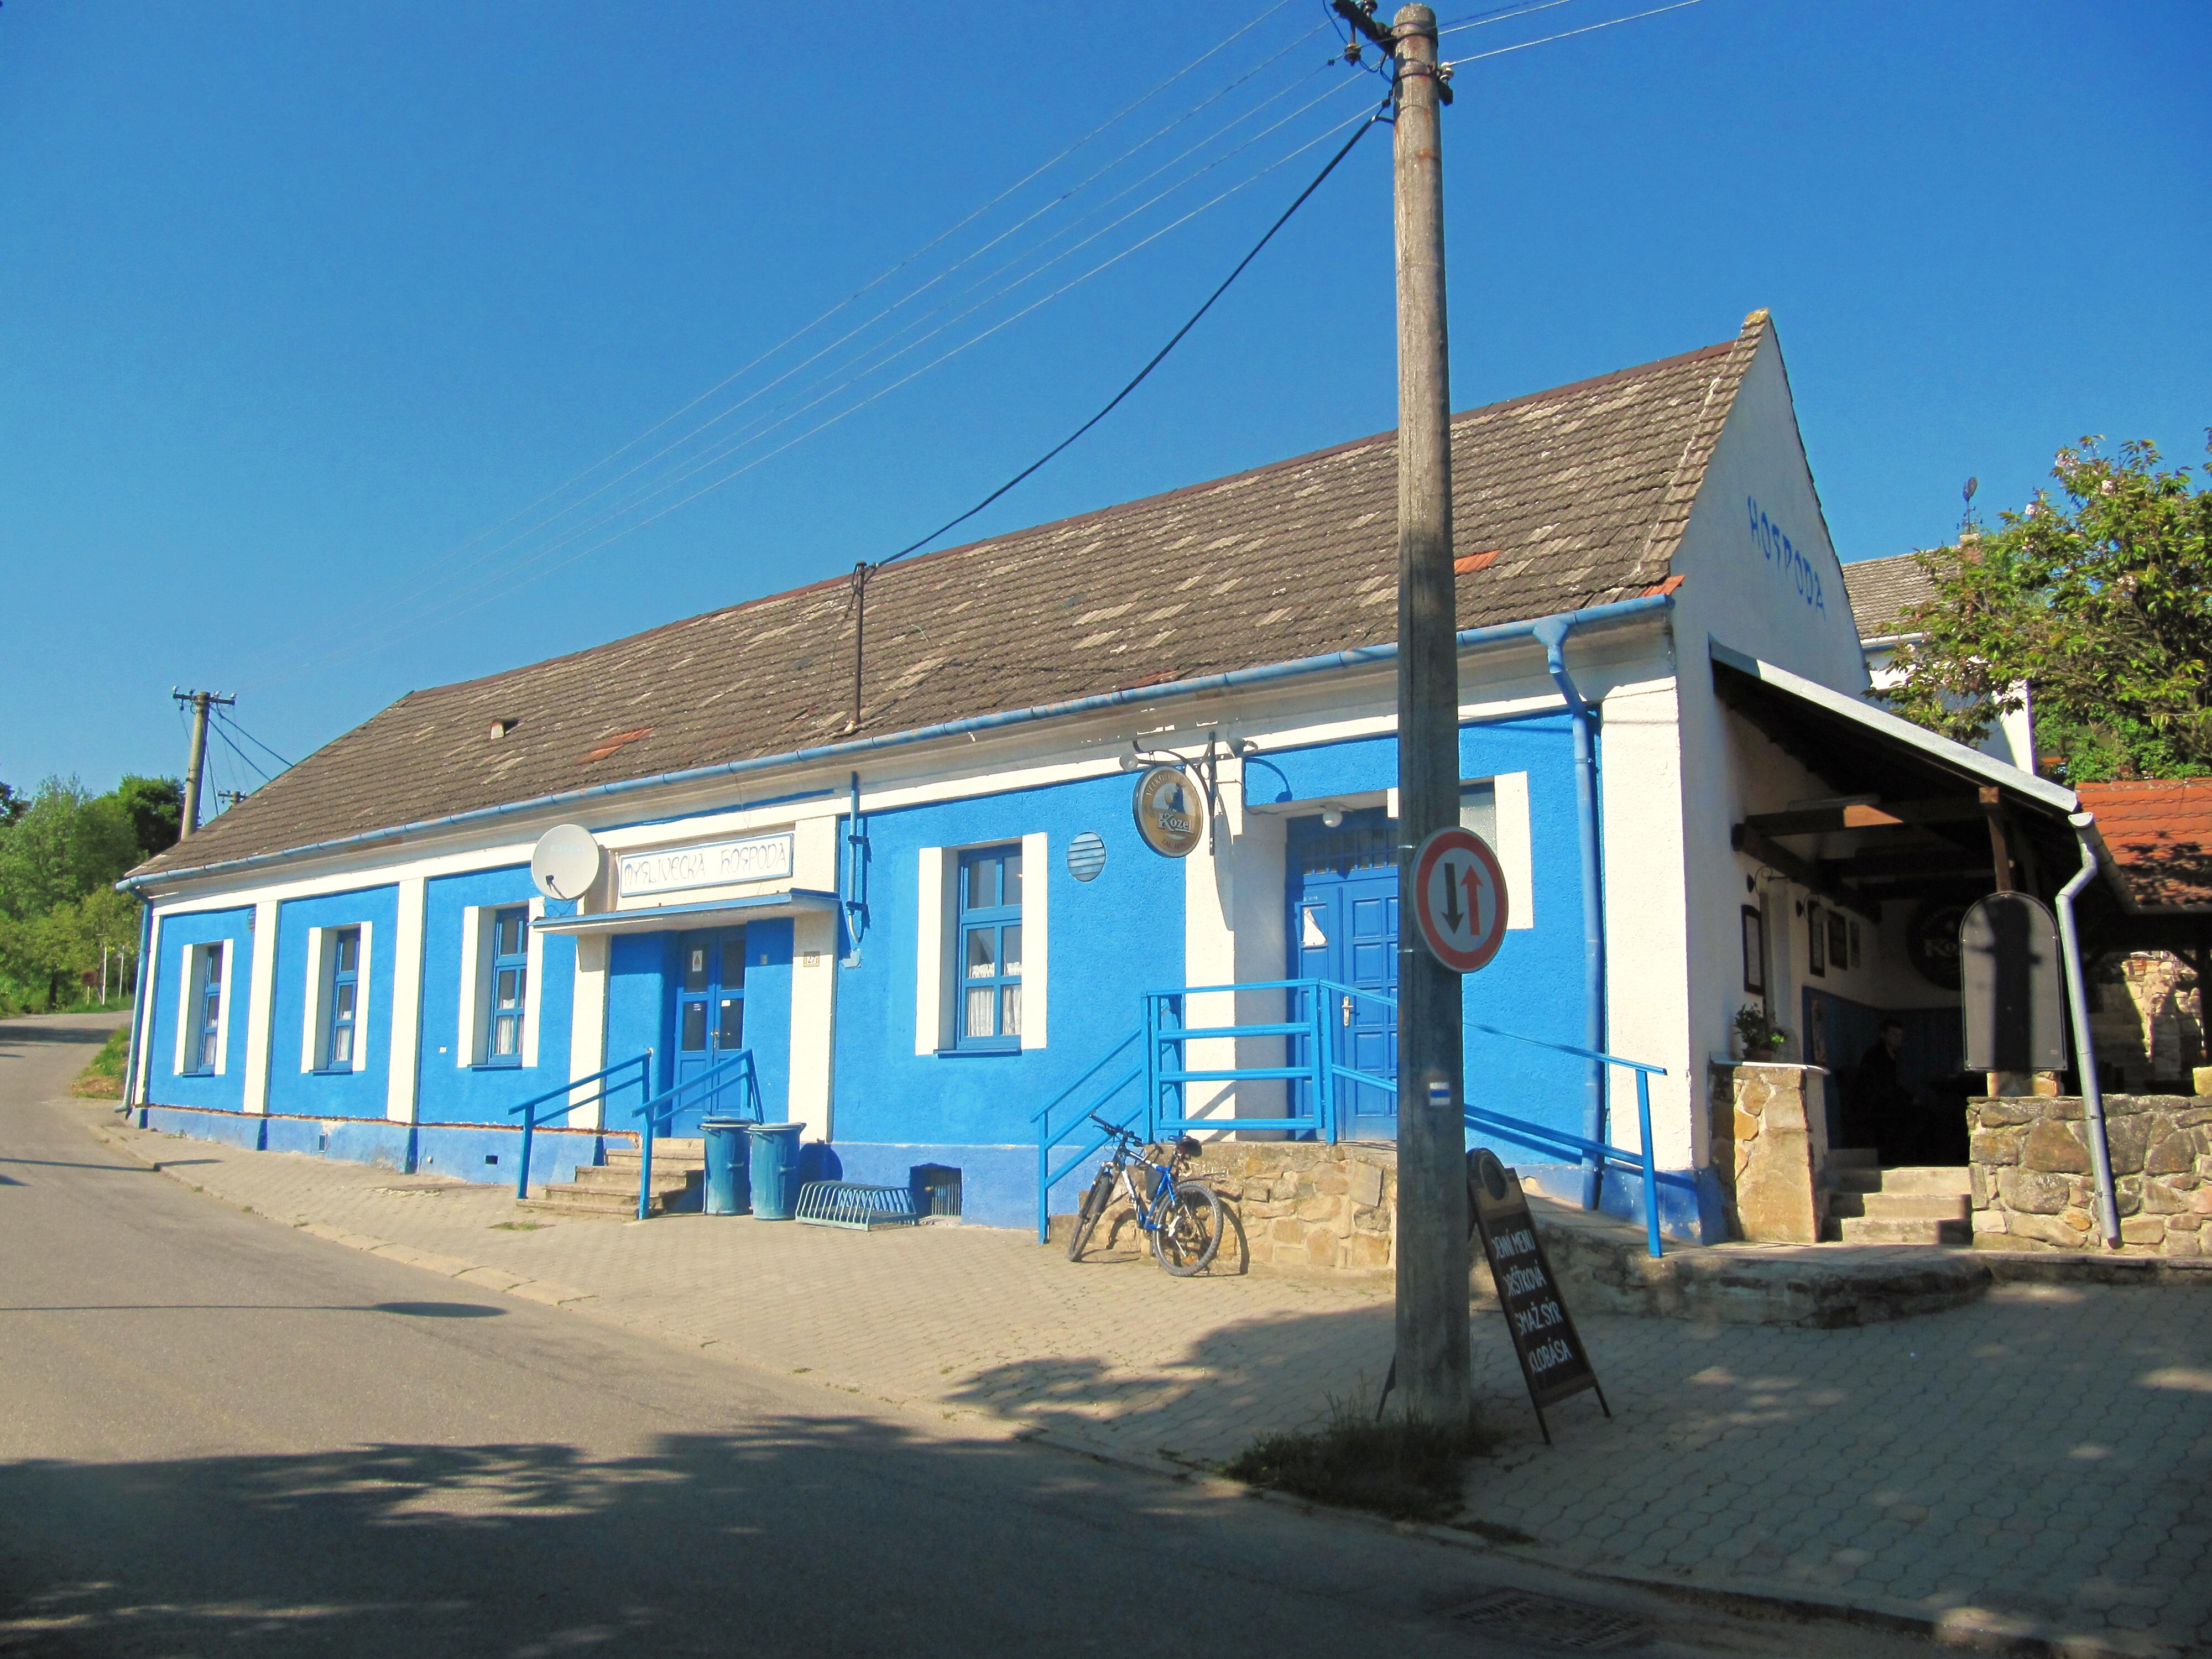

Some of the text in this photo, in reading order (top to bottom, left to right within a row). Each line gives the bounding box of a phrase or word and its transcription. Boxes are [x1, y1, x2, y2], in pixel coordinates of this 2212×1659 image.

[1747, 495, 1825, 620] HOSPODA
[1157, 812, 1193, 833] Kozel
[807, 955, 816, 963] 27
[1511, 1229, 1536, 1254] MENU
[1541, 1296, 1563, 1326] SÝR
[1528, 1337, 1573, 1374] KLOBÁSA
